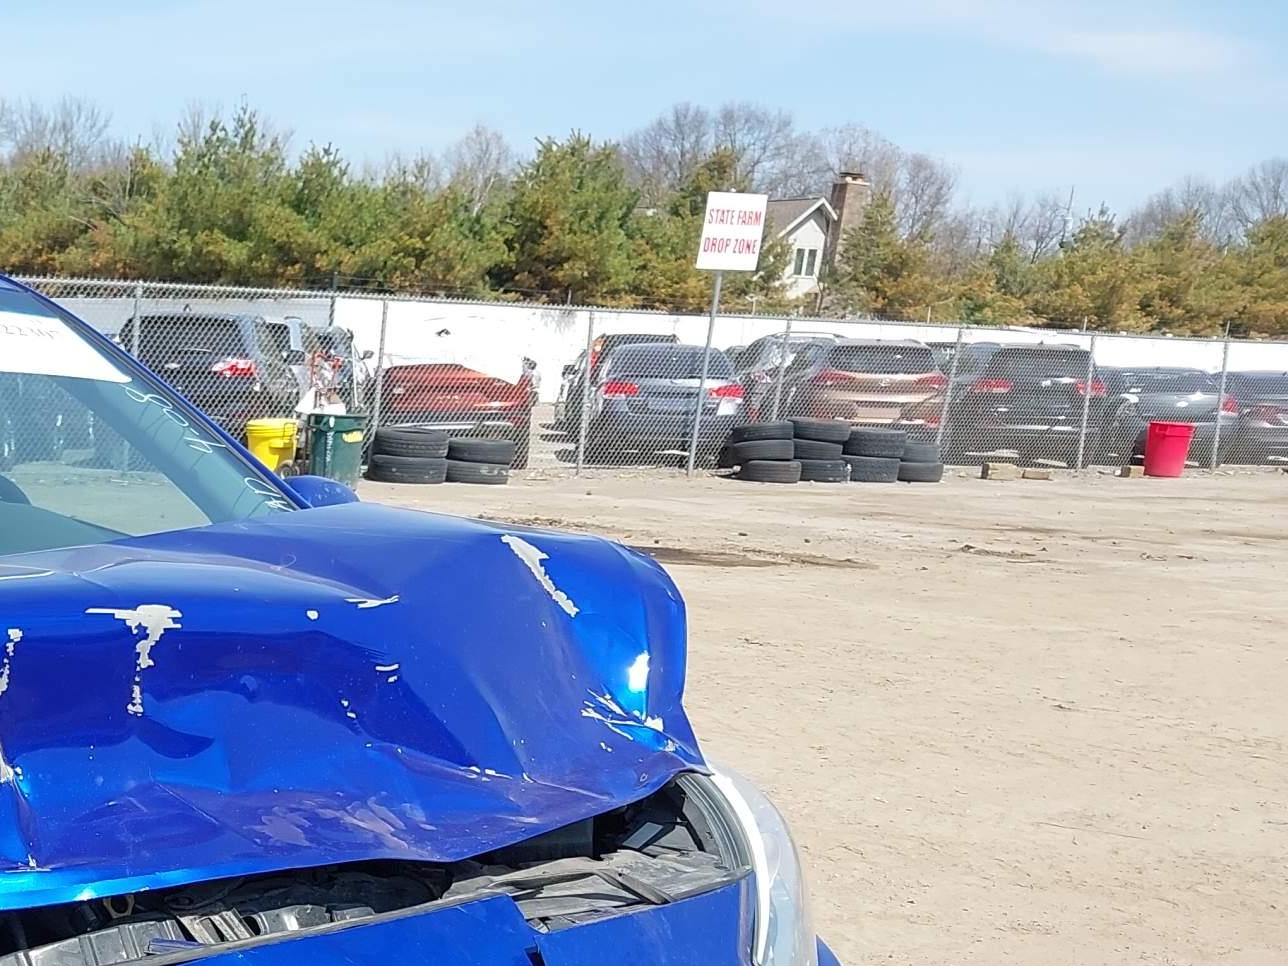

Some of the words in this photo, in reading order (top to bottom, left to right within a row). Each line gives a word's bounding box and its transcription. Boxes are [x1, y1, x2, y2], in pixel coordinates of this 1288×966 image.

[707, 208, 737, 225] STATE
[737, 210, 762, 226] FARM
[703, 237, 731, 254] DROP
[732, 238, 758, 255] ZONE
